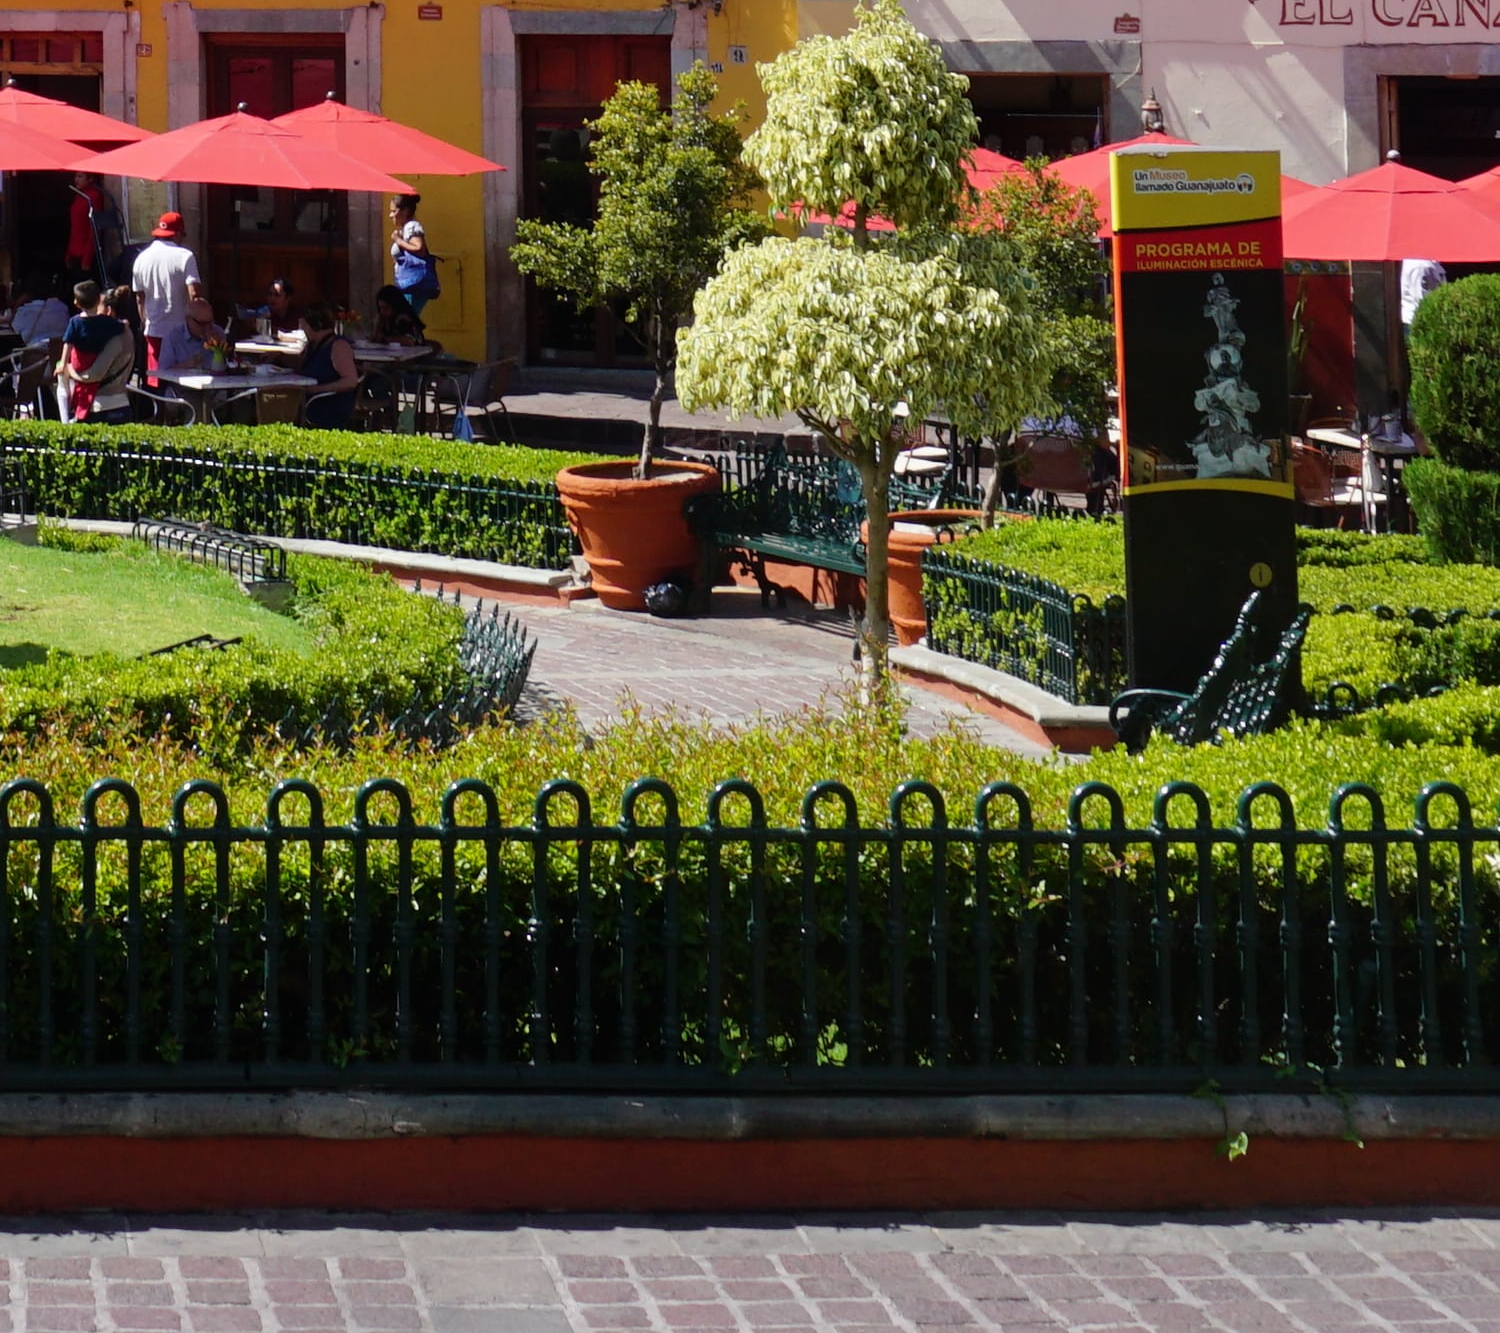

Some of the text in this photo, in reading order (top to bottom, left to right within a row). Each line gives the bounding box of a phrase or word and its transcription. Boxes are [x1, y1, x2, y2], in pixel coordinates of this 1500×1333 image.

[1134, 170, 1186, 181] Un Museo
[1135, 180, 1236, 193] llamado Guanajuato
[1136, 241, 1261, 257] PROGRAMA DE
[1136, 257, 1264, 270] ILUMINACIÓN ESCÉNICA
